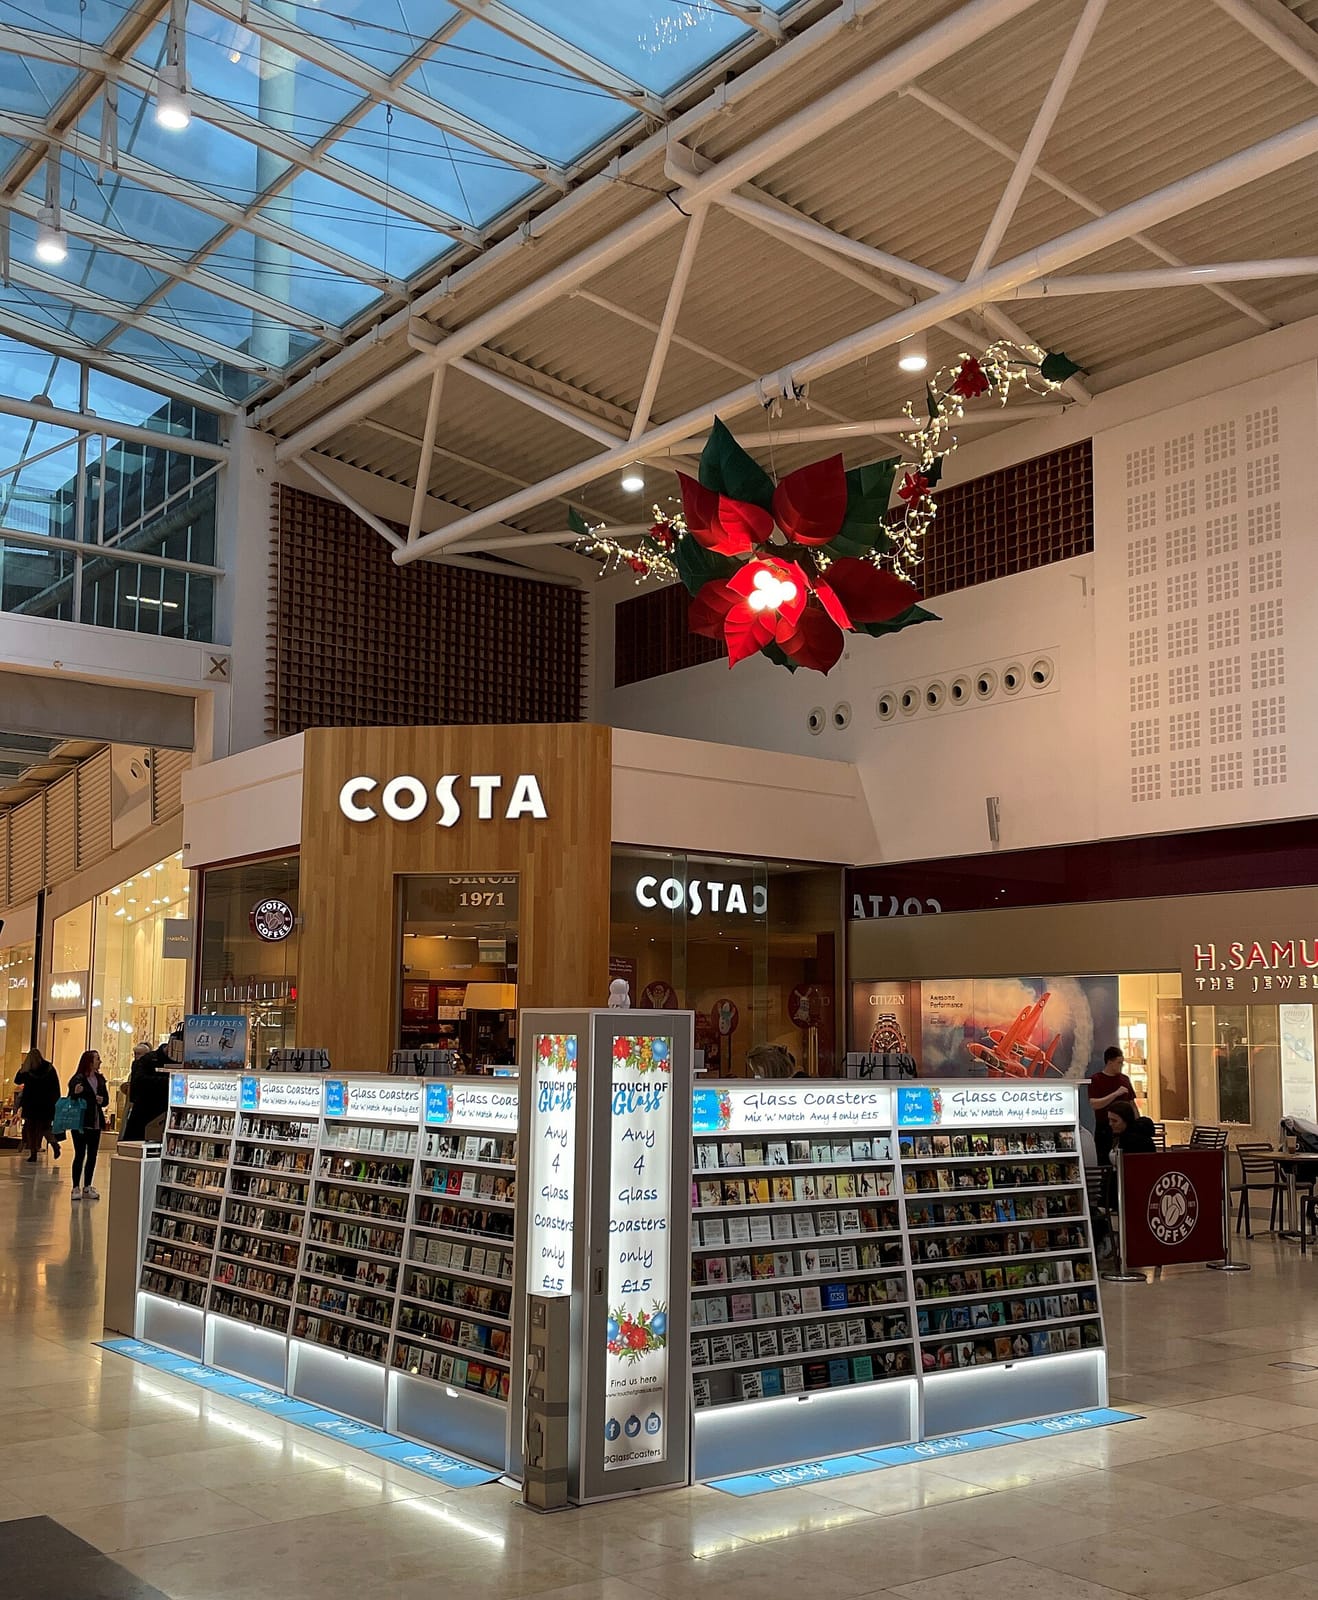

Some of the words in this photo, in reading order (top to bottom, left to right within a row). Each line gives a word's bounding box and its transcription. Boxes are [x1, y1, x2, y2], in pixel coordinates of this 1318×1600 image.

[339, 775, 549, 827] COSTA
[459, 892, 505, 906] 1971
[636, 876, 748, 915] COSTA
[261, 902, 287, 914] COSTA
[258, 922, 290, 938] COFFEE
[1195, 977, 1234, 991] THE
[869, 994, 905, 1006] CITIZEN
[190, 1081, 207, 1091] Glass
[209, 1082, 237, 1092] Coasters
[262, 1083, 284, 1095] Glass
[286, 1084, 320, 1096] Coasters
[539, 1081, 565, 1091] TOUCH
[567, 1082, 577, 1091] OF
[612, 1083, 651, 1092] TOUCH
[654, 1083, 668, 1092] OF
[351, 1088, 376, 1100] Glass
[379, 1089, 419, 1101] Coasters
[456, 1091, 488, 1106] Glass
[538, 1088, 573, 1113] Glass
[612, 1088, 663, 1115] Glass
[743, 1092, 797, 1109] Glass
[804, 1092, 877, 1106] Coasters
[952, 1090, 996, 1106] Glass
[1002, 1090, 1063, 1102] Coasters
[744, 1112, 761, 1122] Mix
[778, 1112, 805, 1122] Match
[810, 1112, 829, 1125] Any
[832, 1111, 837, 1123] 4
[839, 1111, 859, 1125] only
[861, 1111, 879, 1120] £15
[953, 1108, 968, 1118] Mix
[981, 1107, 1003, 1117] Match
[1007, 1108, 1024, 1120] Any
[1026, 1107, 1031, 1118] 4
[1032, 1107, 1048, 1120] only
[1049, 1107, 1064, 1116] £15
[544, 1126, 568, 1147] Any
[621, 1128, 655, 1147] Any
[552, 1153, 560, 1174] 4
[633, 1155, 645, 1175] 4
[541, 1185, 569, 1201] Glass
[1156, 1174, 1190, 1196] COSTA
[618, 1187, 658, 1205] Glass
[534, 1214, 574, 1232] Coasters
[608, 1217, 666, 1232] Coasters
[1151, 1215, 1194, 1242] COFFEE
[541, 1246, 565, 1268] only
[619, 1247, 653, 1268] only
[542, 1275, 564, 1291] £15
[621, 1278, 652, 1293] £15
[610, 1378, 626, 1387] Find
[629, 1378, 637, 1386] us
[640, 1376, 657, 1384] here
